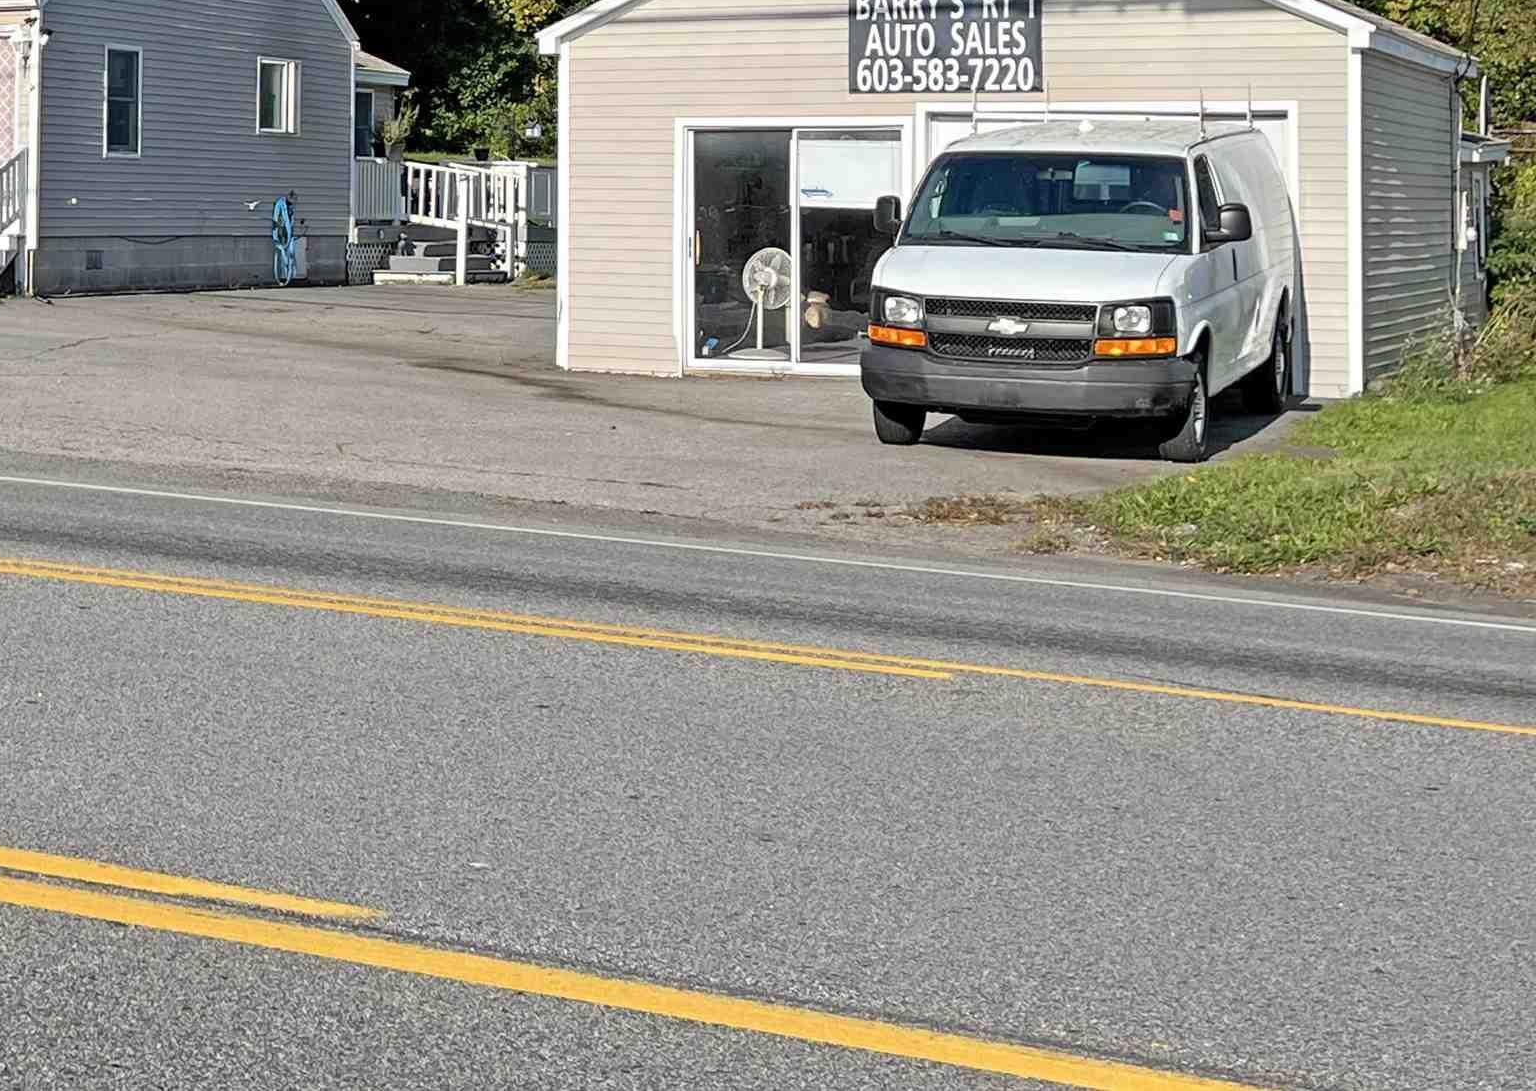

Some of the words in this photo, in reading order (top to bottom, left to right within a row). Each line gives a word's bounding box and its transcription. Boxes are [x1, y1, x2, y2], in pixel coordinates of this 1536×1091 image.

[865, 21, 936, 57] AUTO
[950, 21, 1027, 56] SALES
[856, 57, 1035, 92] 603-583-7220
